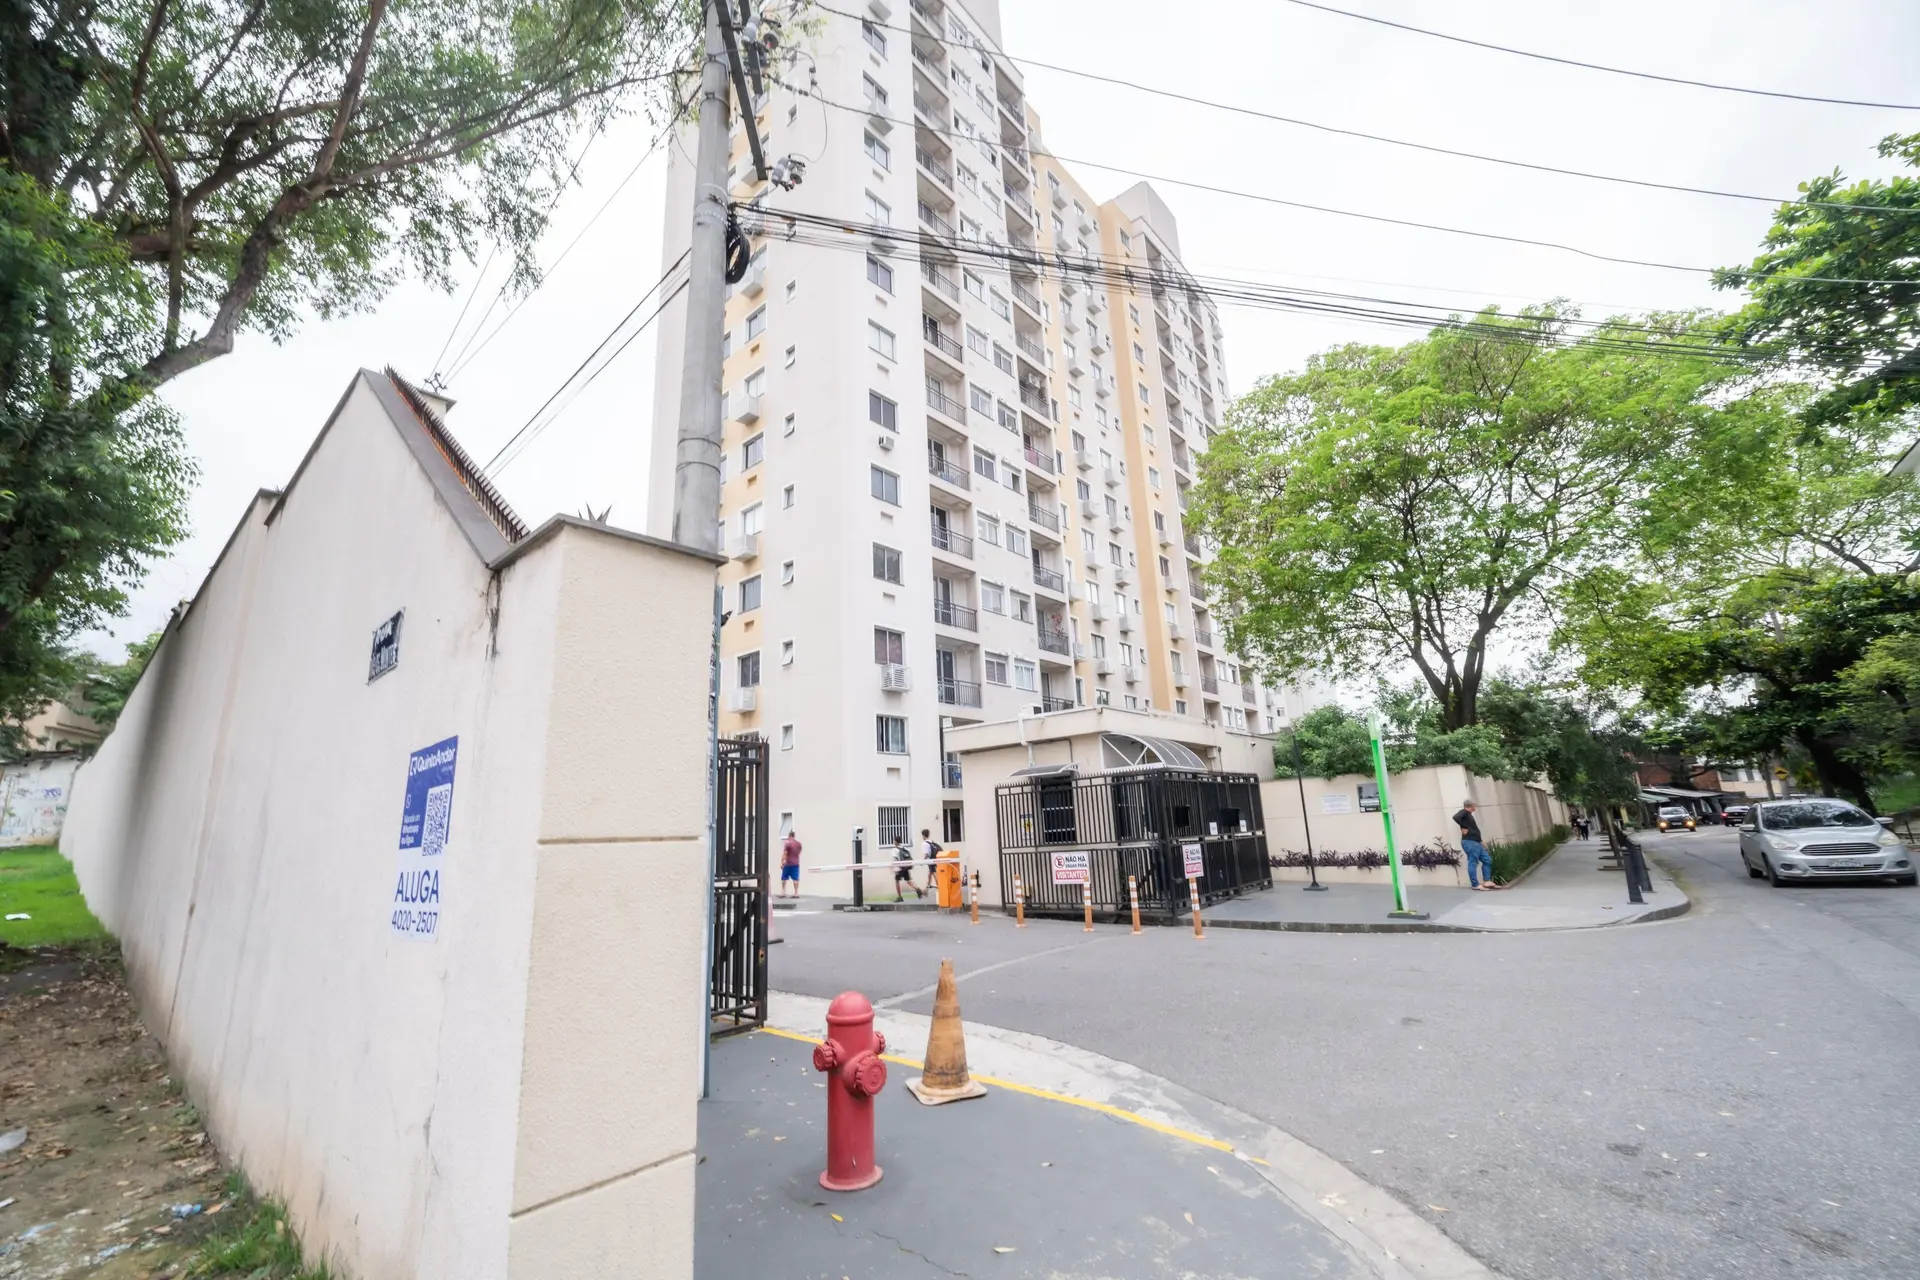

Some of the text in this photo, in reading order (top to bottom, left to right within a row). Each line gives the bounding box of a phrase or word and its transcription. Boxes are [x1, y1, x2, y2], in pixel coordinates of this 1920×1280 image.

[417, 746, 456, 772] QuintoAndar
[395, 870, 439, 903] ALUGA
[392, 910, 438, 933] 4020-2507
